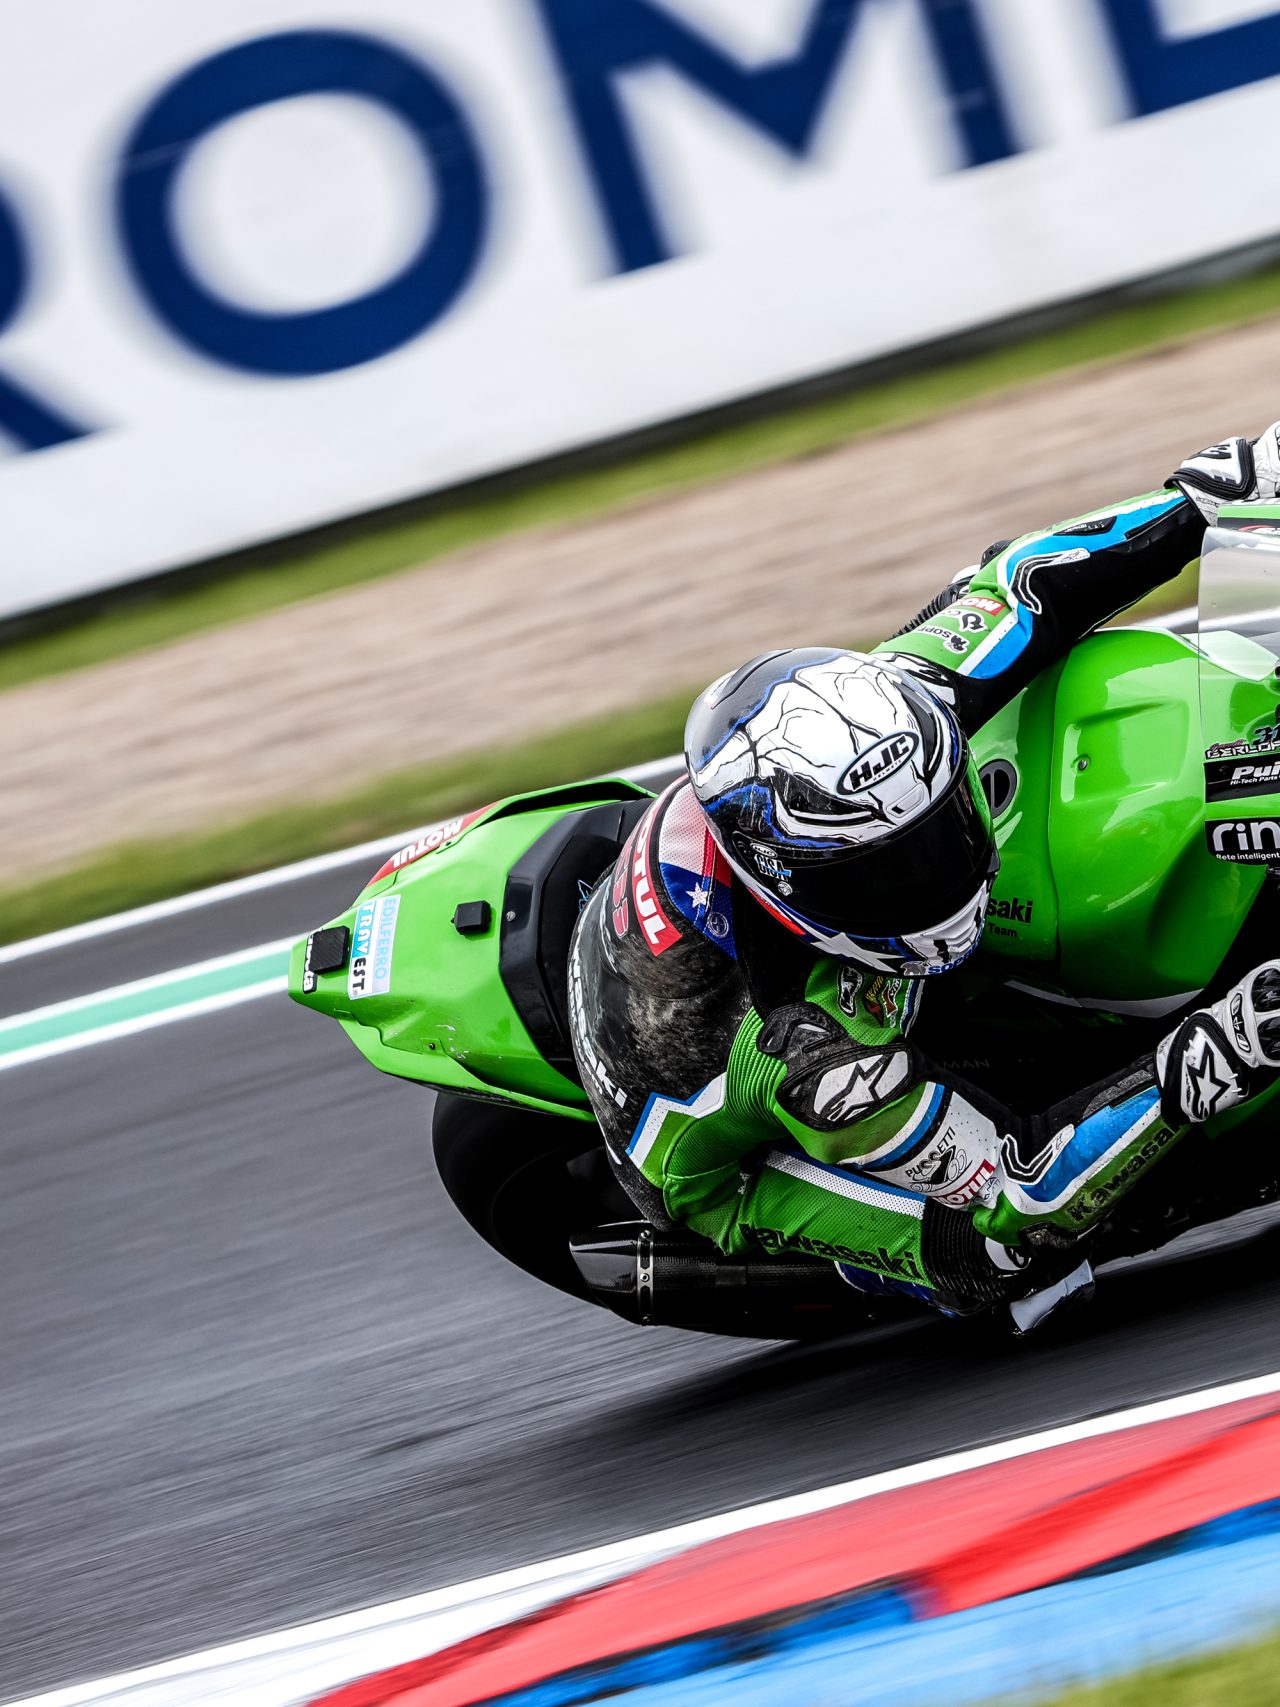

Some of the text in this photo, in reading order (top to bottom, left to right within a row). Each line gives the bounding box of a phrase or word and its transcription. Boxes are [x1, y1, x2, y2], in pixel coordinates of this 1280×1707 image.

[849, 735, 911, 792] HJC
[1230, 778, 1258, 786] Hi-Tech
[391, 817, 464, 868] MOTUL
[374, 898, 396, 980] EDILFERRO
[988, 923, 1019, 938] Team
